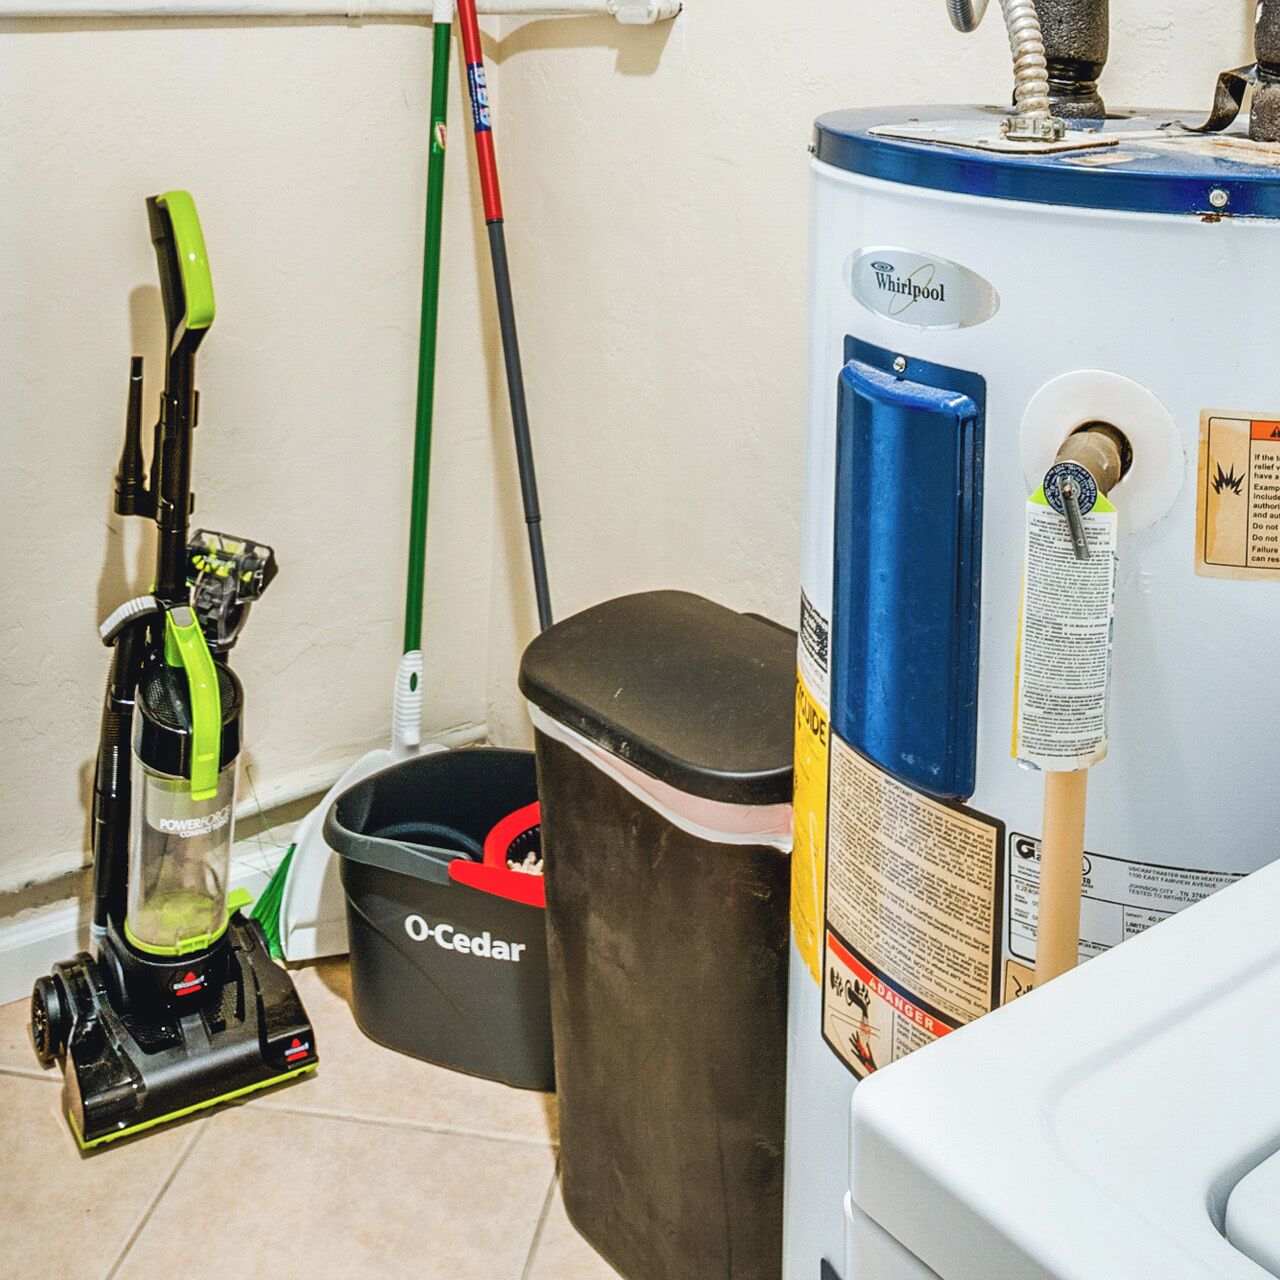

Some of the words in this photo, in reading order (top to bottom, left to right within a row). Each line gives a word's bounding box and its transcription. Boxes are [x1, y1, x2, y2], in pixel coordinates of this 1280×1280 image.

[874, 271, 946, 303] Whirlpool
[1254, 453, 1261, 461] If
[1253, 463, 1275, 471] relief
[1252, 522, 1264, 530] Do
[1265, 523, 1279, 531] not
[1251, 545, 1279, 554] Failure
[883, 778, 914, 799] IMPORTANT
[1160, 876, 1191, 886] FAIRVIEW
[1191, 880, 1217, 889] AVENUE
[1179, 873, 1200, 881] WATER
[1200, 875, 1224, 883] HEATER
[1128, 888, 1153, 897] TESTED
[1163, 893, 1201, 903] WITHSTAND
[1129, 883, 1159, 893] JOHNSON
[1159, 887, 1174, 895] CITY
[404, 913, 527, 963] O-Cedar
[881, 935, 912, 962] CALIFORNIA
[912, 958, 935, 976] NOTICE
[876, 982, 936, 1033] DANGER
